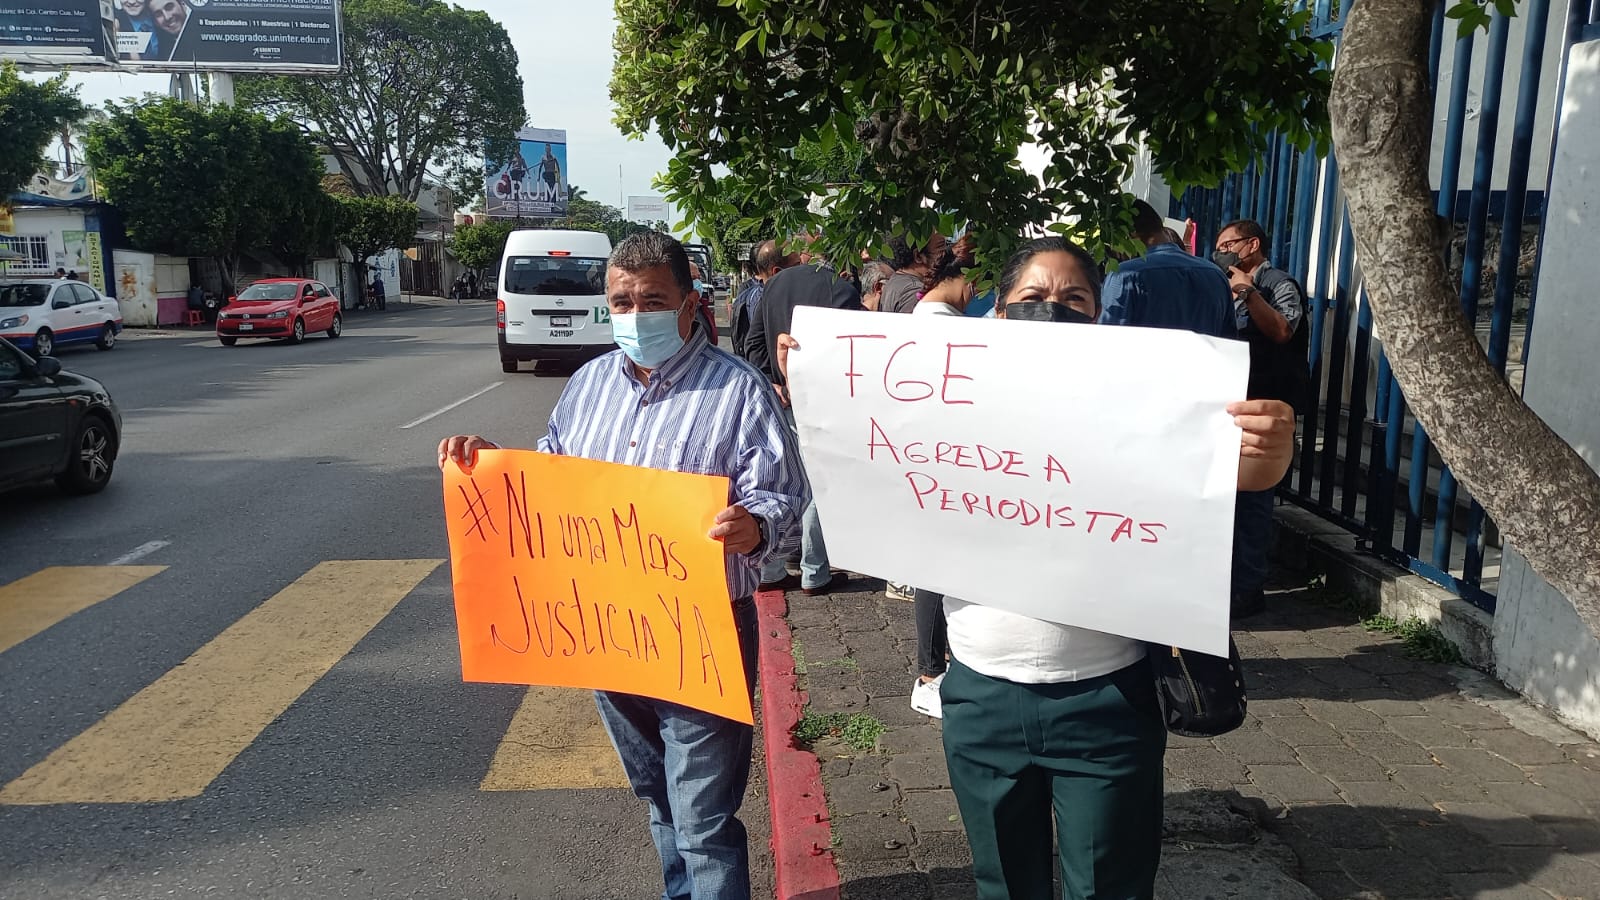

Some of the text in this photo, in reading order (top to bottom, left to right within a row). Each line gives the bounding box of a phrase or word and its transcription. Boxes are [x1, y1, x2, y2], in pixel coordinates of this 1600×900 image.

[200, 33, 330, 44] www.posgrados.uninter.edu.mx
[205, 19, 247, 27] Especialidades
[836, 334, 987, 406] FGE
[866, 417, 1071, 484] AGREDE A
[904, 471, 1168, 544] PERIODISTAS
